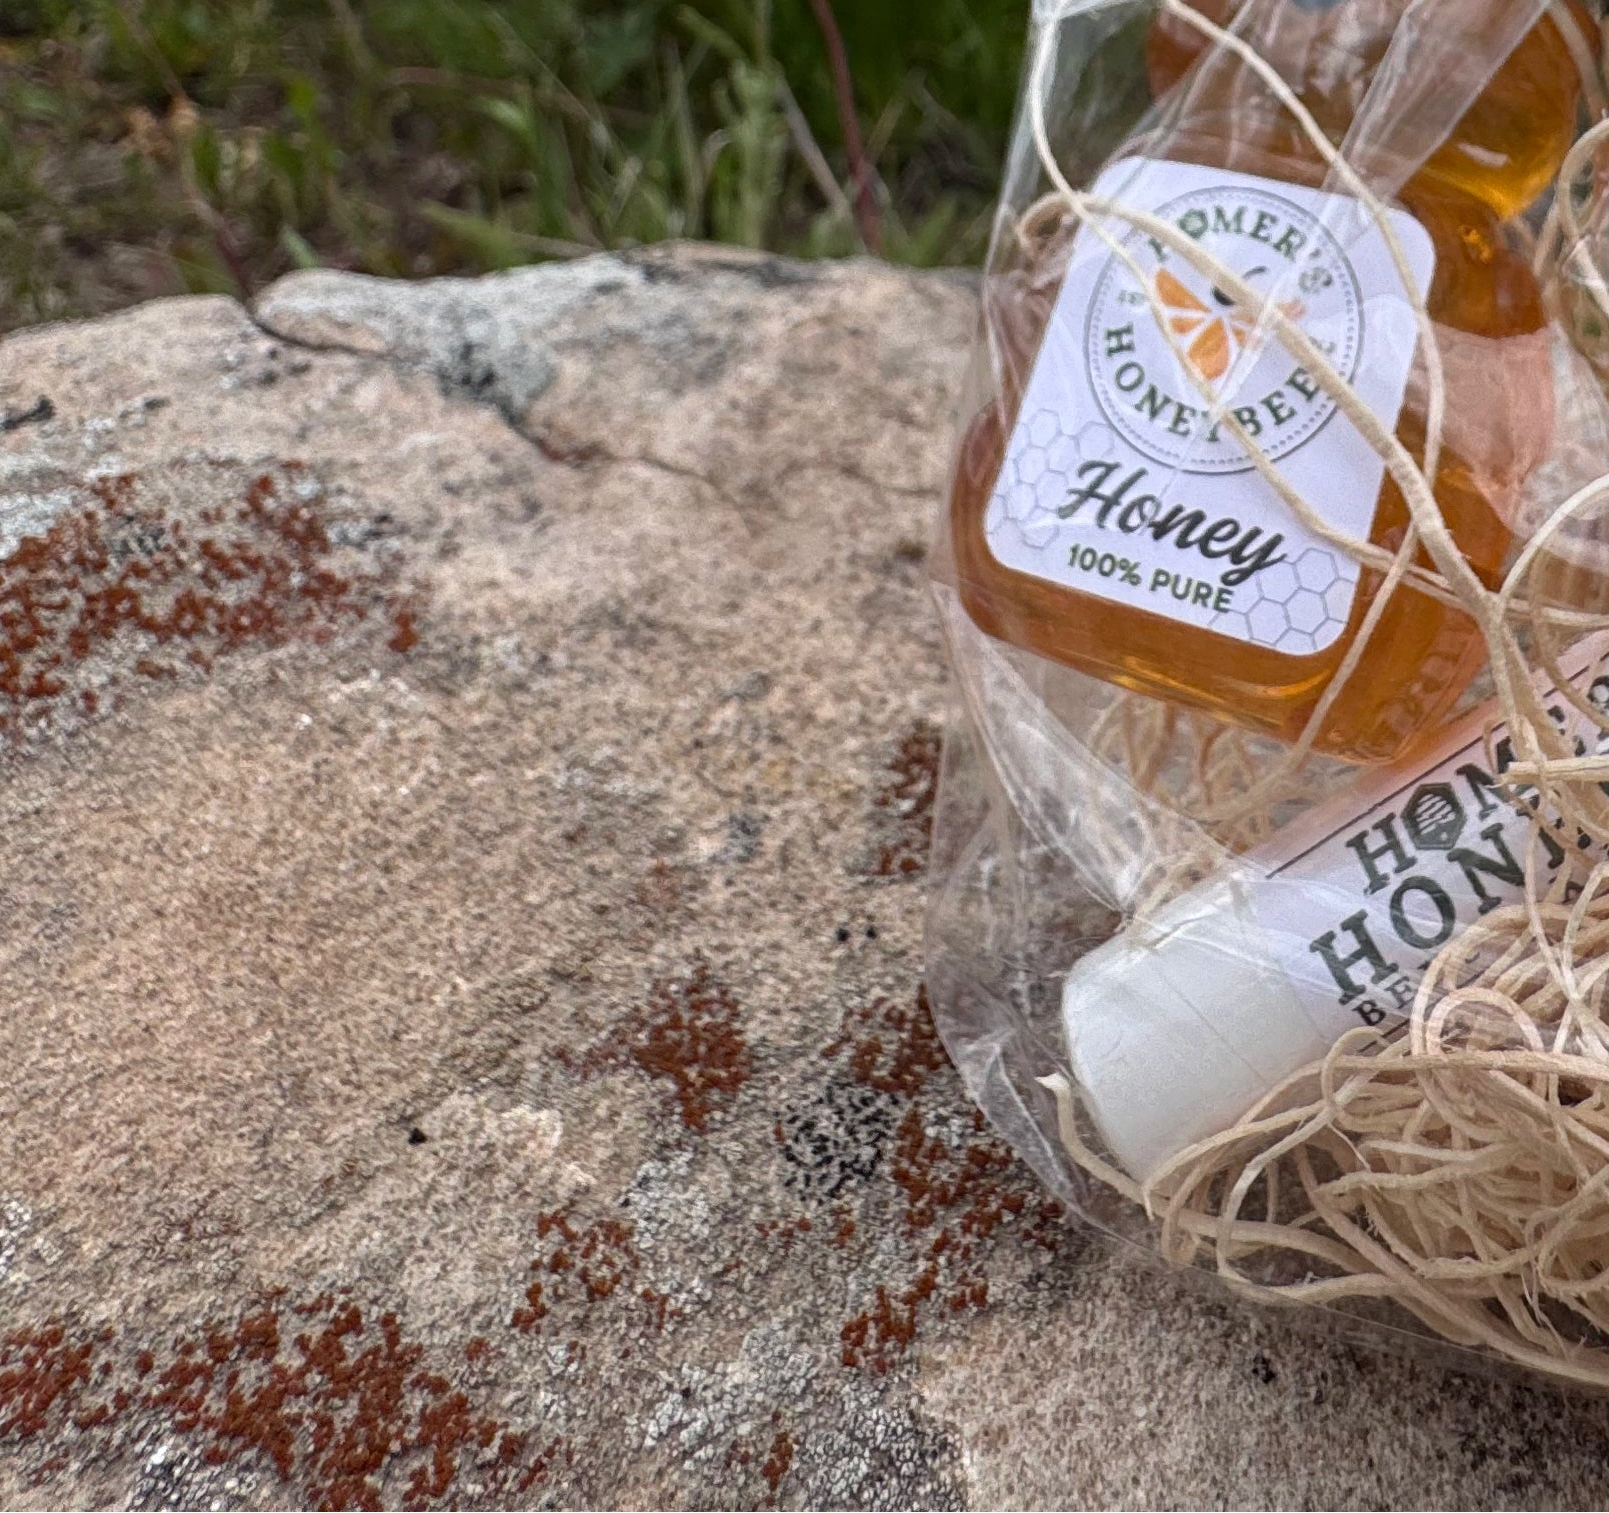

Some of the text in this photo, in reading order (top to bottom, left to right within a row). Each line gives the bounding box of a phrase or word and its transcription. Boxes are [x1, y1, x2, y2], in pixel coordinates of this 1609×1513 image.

[1057, 460, 1287, 586] Honey
[1067, 544, 1235, 614] 100% PURE
